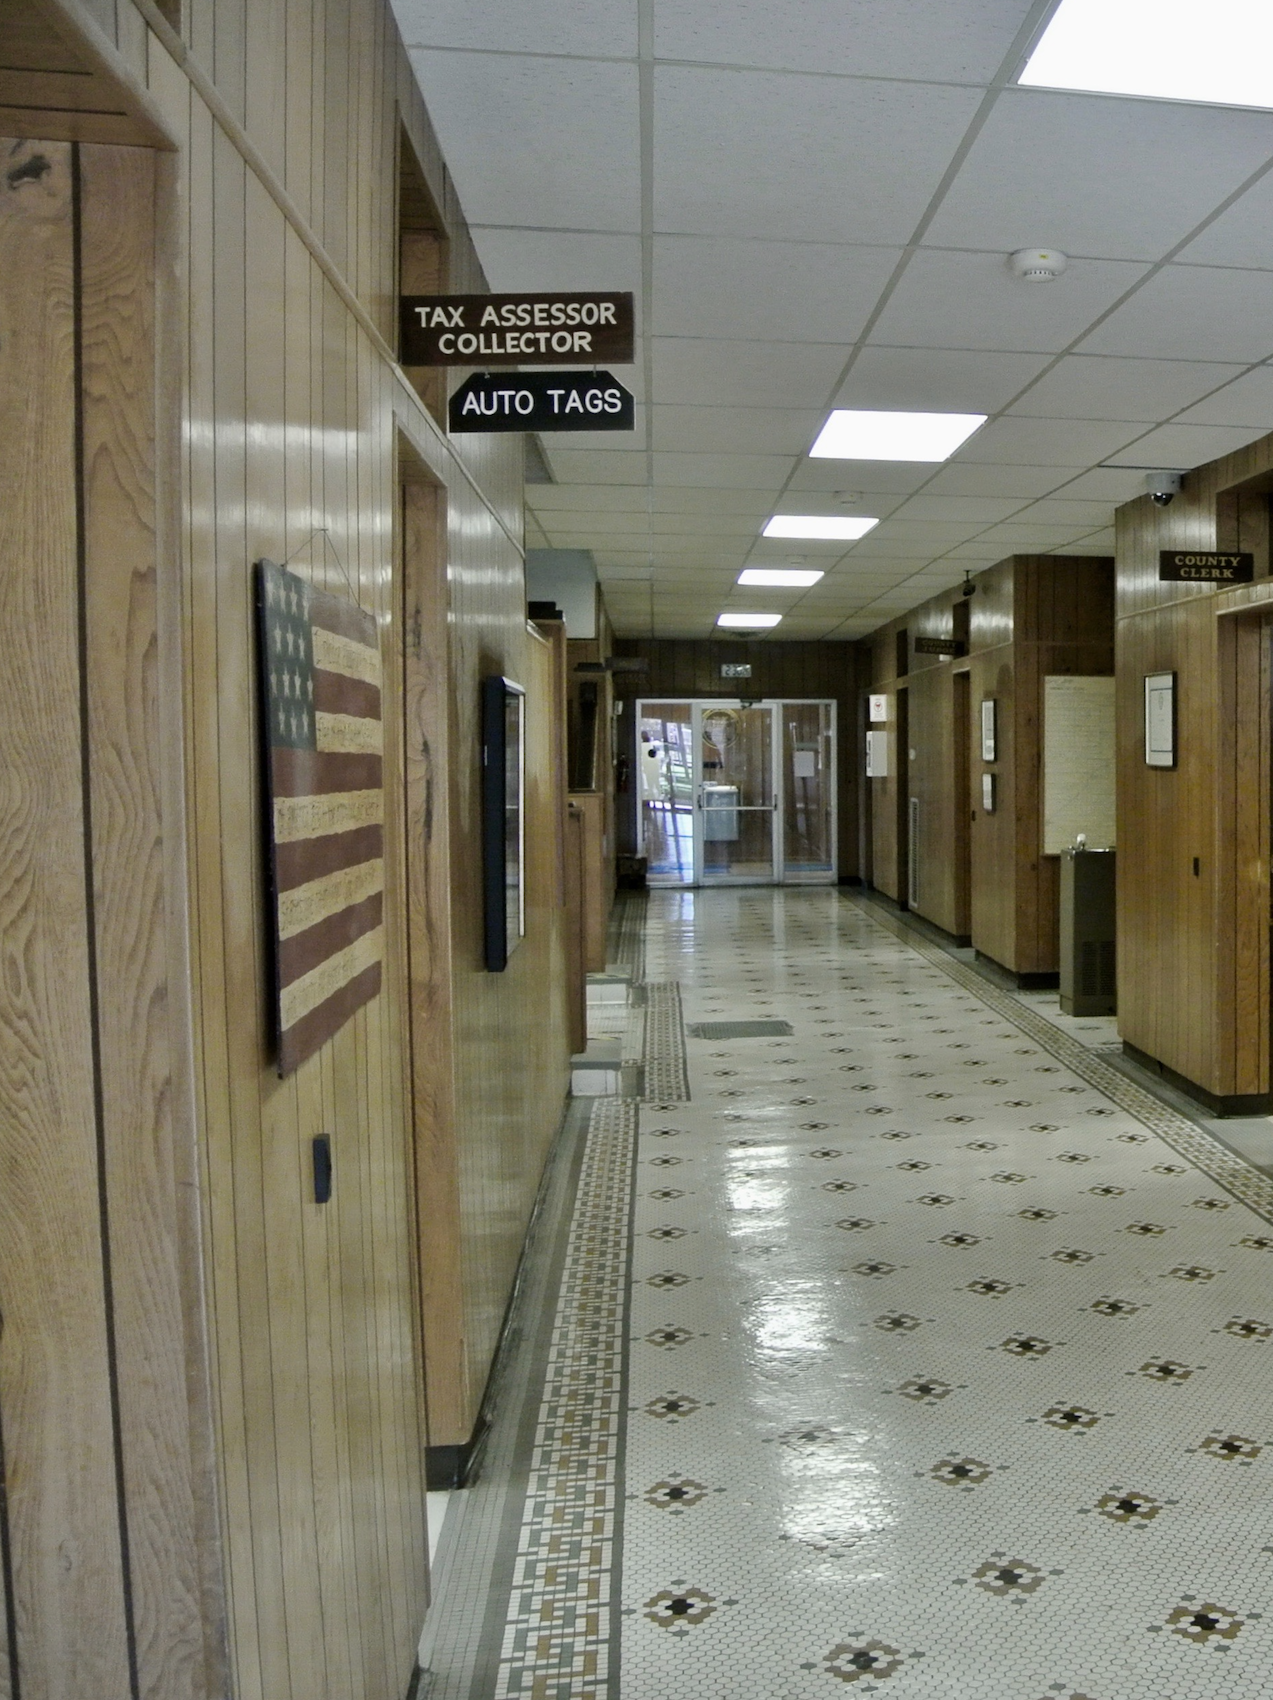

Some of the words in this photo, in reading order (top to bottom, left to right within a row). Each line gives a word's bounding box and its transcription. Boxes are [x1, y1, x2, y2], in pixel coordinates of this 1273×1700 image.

[415, 306, 465, 328] TAX
[480, 302, 617, 327] ASSESSOR
[438, 331, 592, 354] COLLECTOR
[462, 390, 534, 416] AUTO
[547, 389, 622, 414] TAGS
[1174, 555, 1240, 566] COUNTY
[1180, 567, 1234, 578] CLERK
